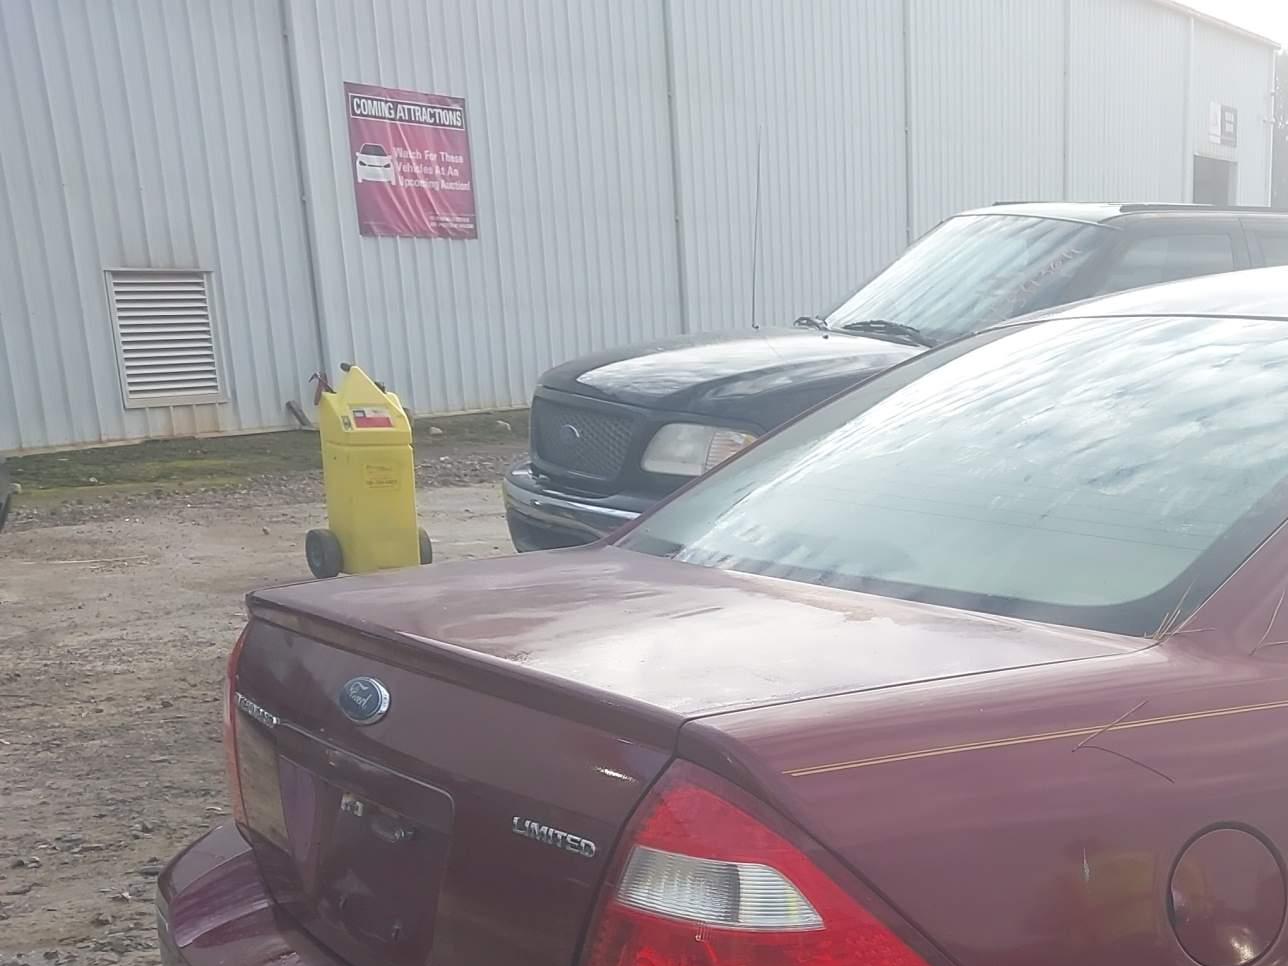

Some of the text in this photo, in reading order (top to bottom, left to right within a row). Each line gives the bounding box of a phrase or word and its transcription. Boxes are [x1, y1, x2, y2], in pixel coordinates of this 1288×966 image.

[353, 98, 462, 126] COMING ATTRACTIONS
[393, 147, 464, 163] Watch For These
[397, 162, 459, 176] Vehicles At An
[512, 816, 596, 858] LIMITED
